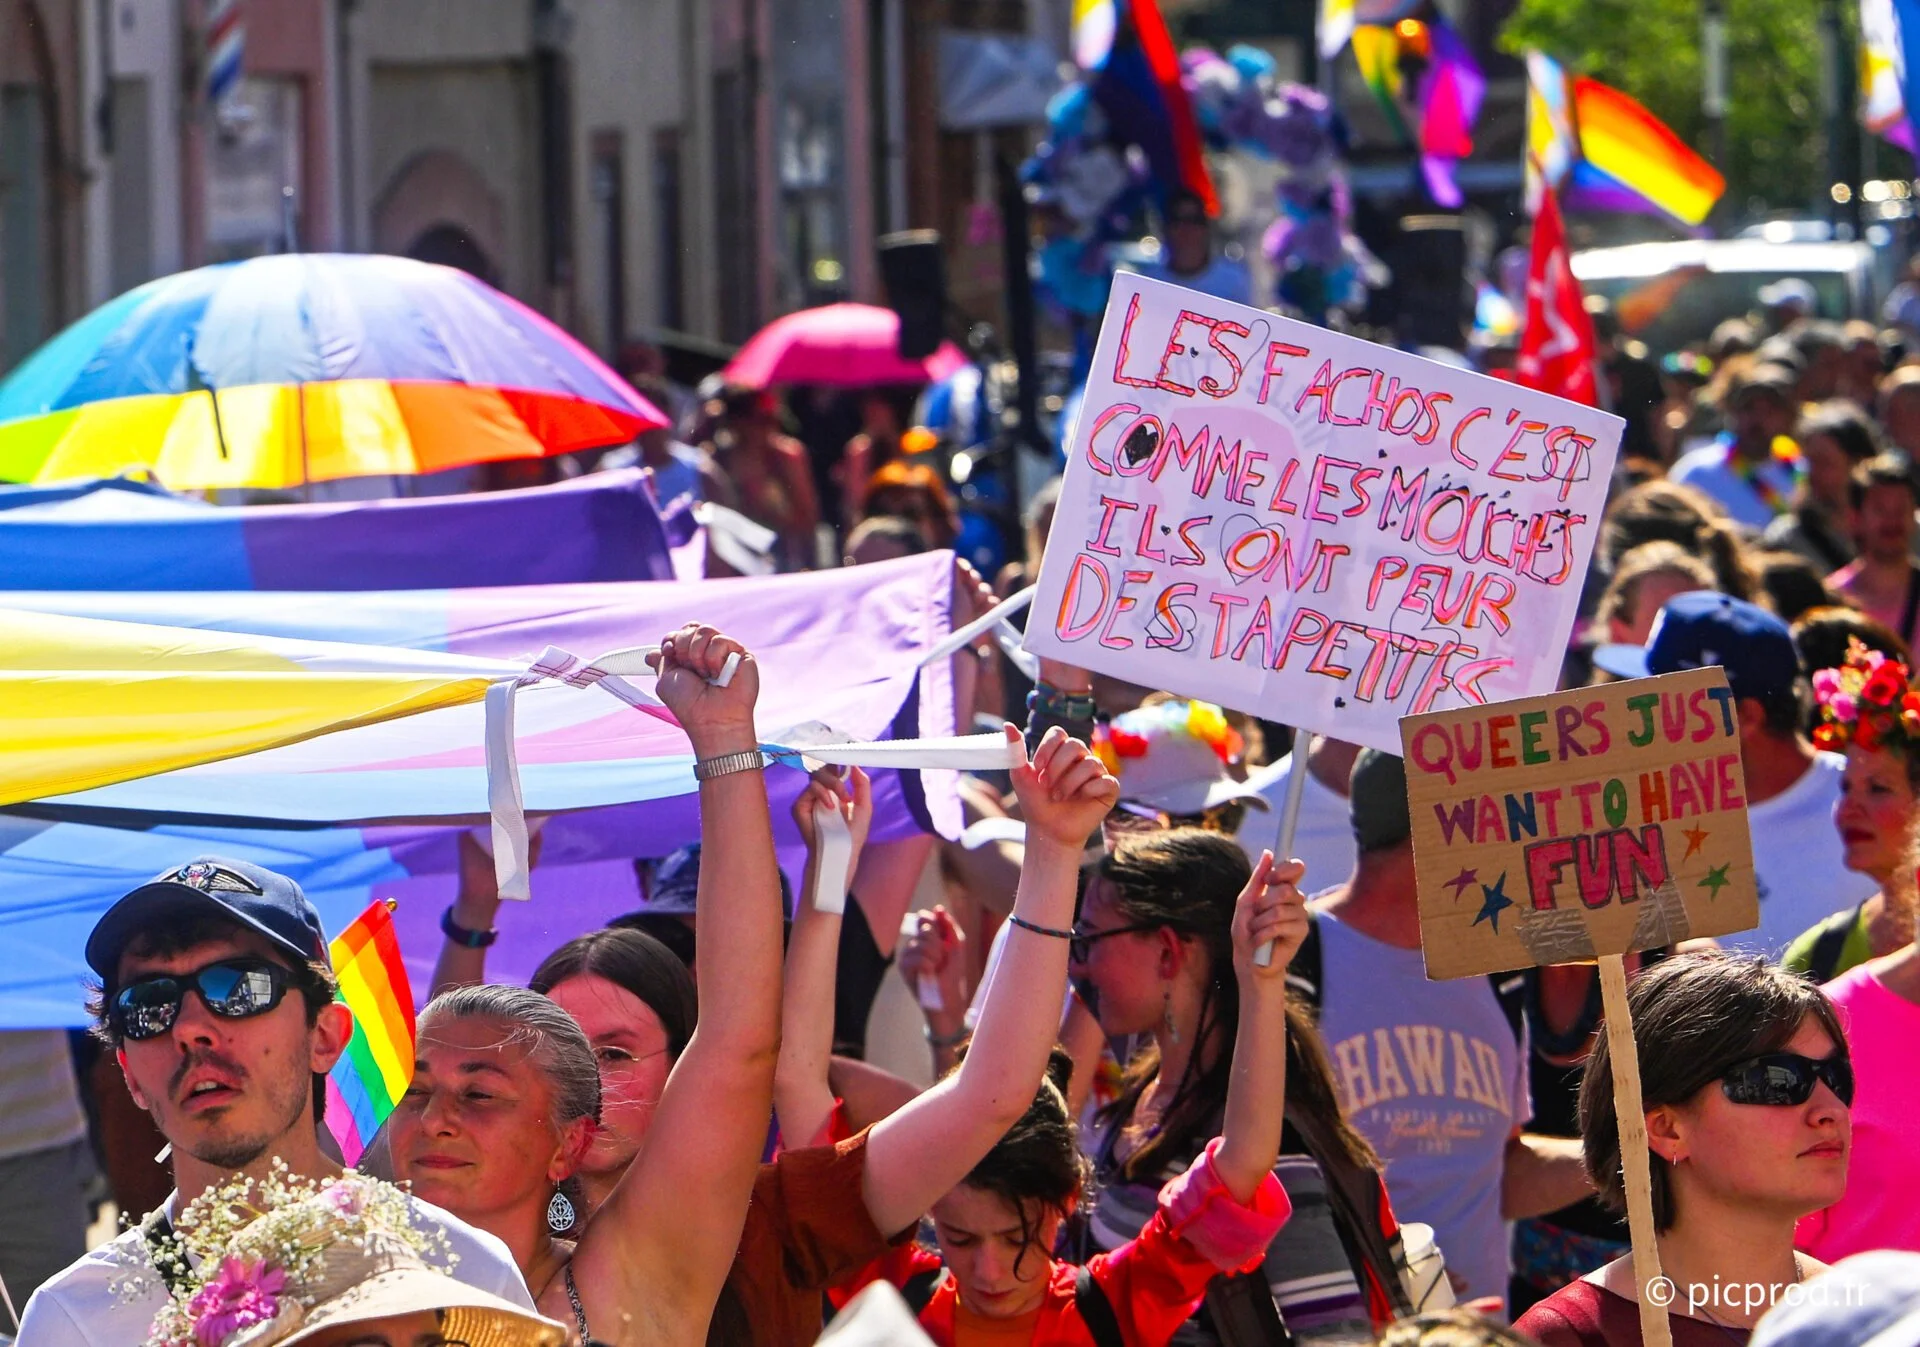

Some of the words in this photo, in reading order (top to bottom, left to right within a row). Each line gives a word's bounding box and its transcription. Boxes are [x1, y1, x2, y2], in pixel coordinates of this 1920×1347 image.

[1113, 292, 1250, 398] LES
[1257, 341, 1453, 446] FACHOS
[1451, 407, 1597, 501] C'EST
[1086, 402, 1268, 505] COMME
[1268, 454, 1382, 523] LES
[1377, 466, 1587, 586] MOUCHES
[1055, 552, 1198, 650] DES
[1085, 495, 1212, 566] ILS
[1224, 521, 1351, 594] ONT
[1366, 556, 1517, 637] PEUR
[1410, 701, 1612, 786] QUEERS
[1626, 687, 1735, 747] JUST
[1433, 788, 1562, 846] WANT
[1571, 778, 1628, 829] TO
[1639, 754, 1746, 823] HAVE
[1523, 822, 1669, 912] FUN
[1335, 1025, 1512, 1118] HAWAII
